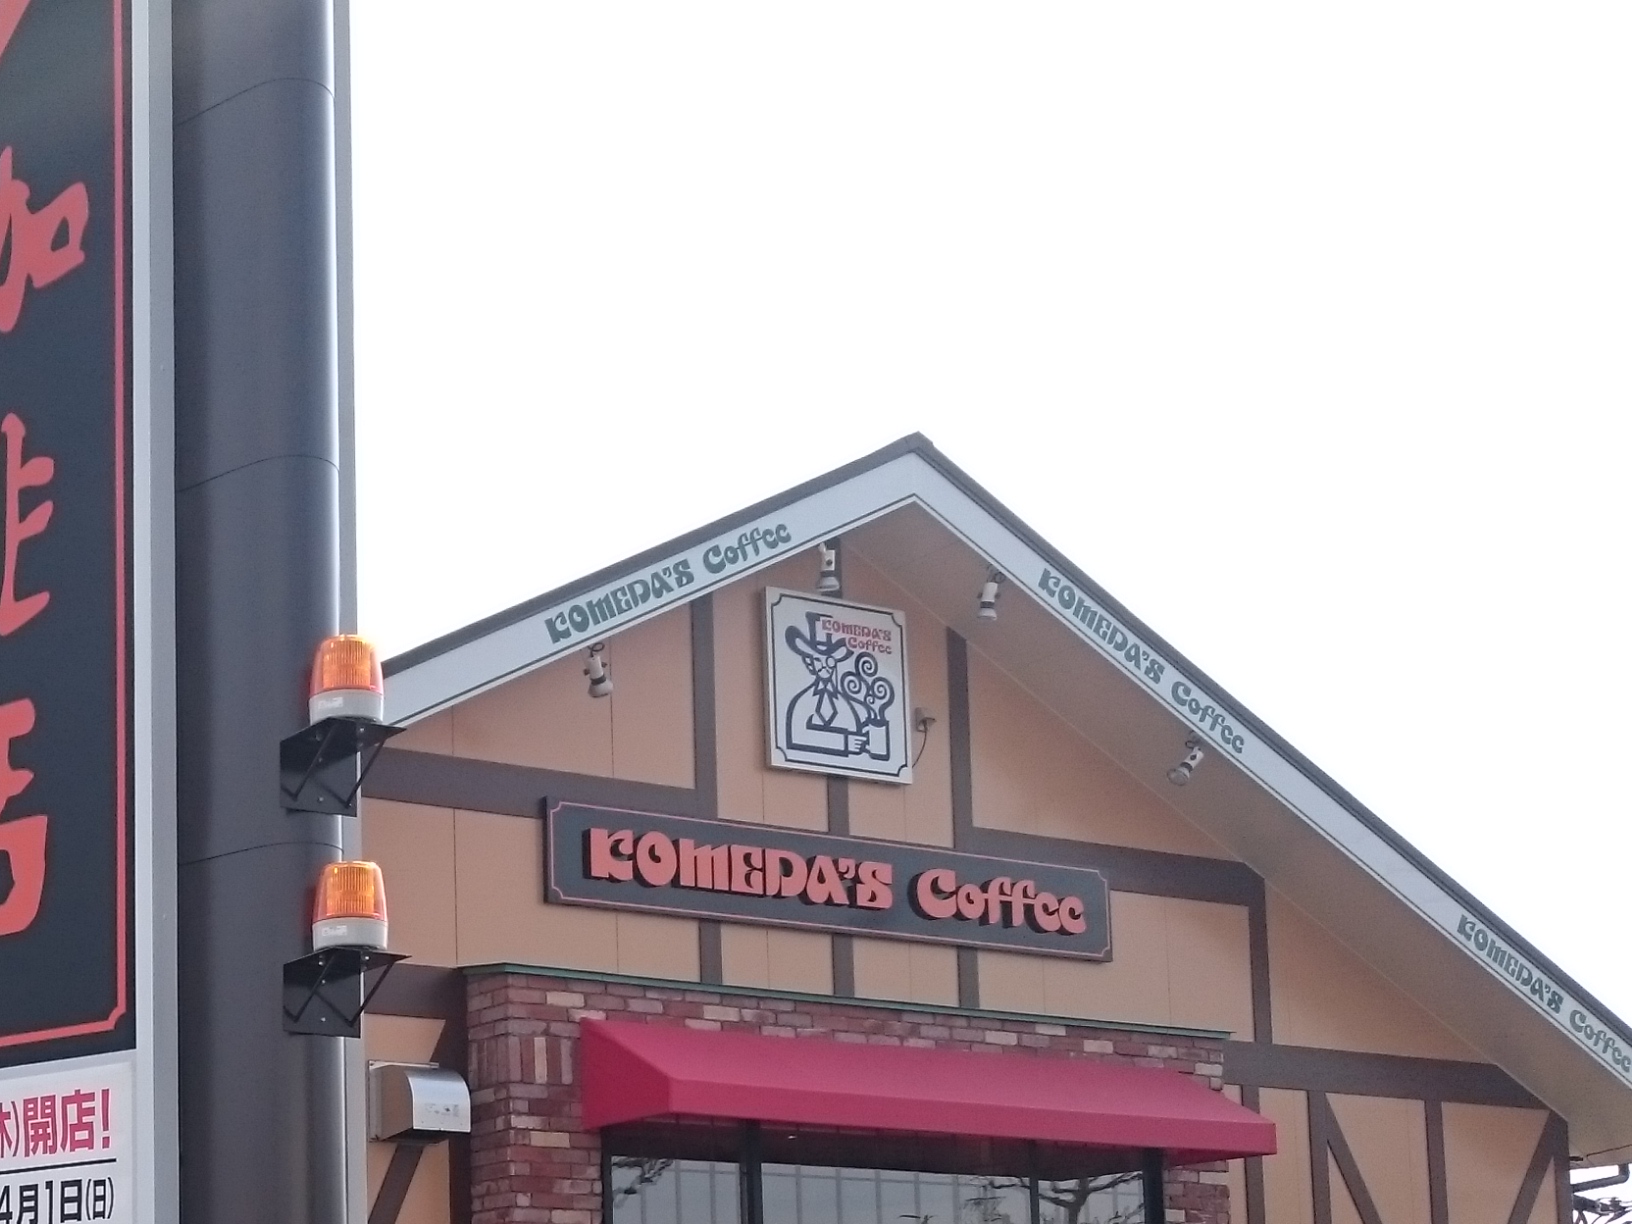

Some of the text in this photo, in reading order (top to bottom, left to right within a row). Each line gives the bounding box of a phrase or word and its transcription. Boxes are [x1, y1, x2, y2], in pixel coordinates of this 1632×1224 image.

[545, 523, 792, 645] KOMEDA'S Coffee
[1038, 567, 1245, 754] KOMEDA'S Coffee
[584, 827, 1087, 936] KOMEDA'S Coffee
[1569, 1008, 1632, 1073] Coffee
